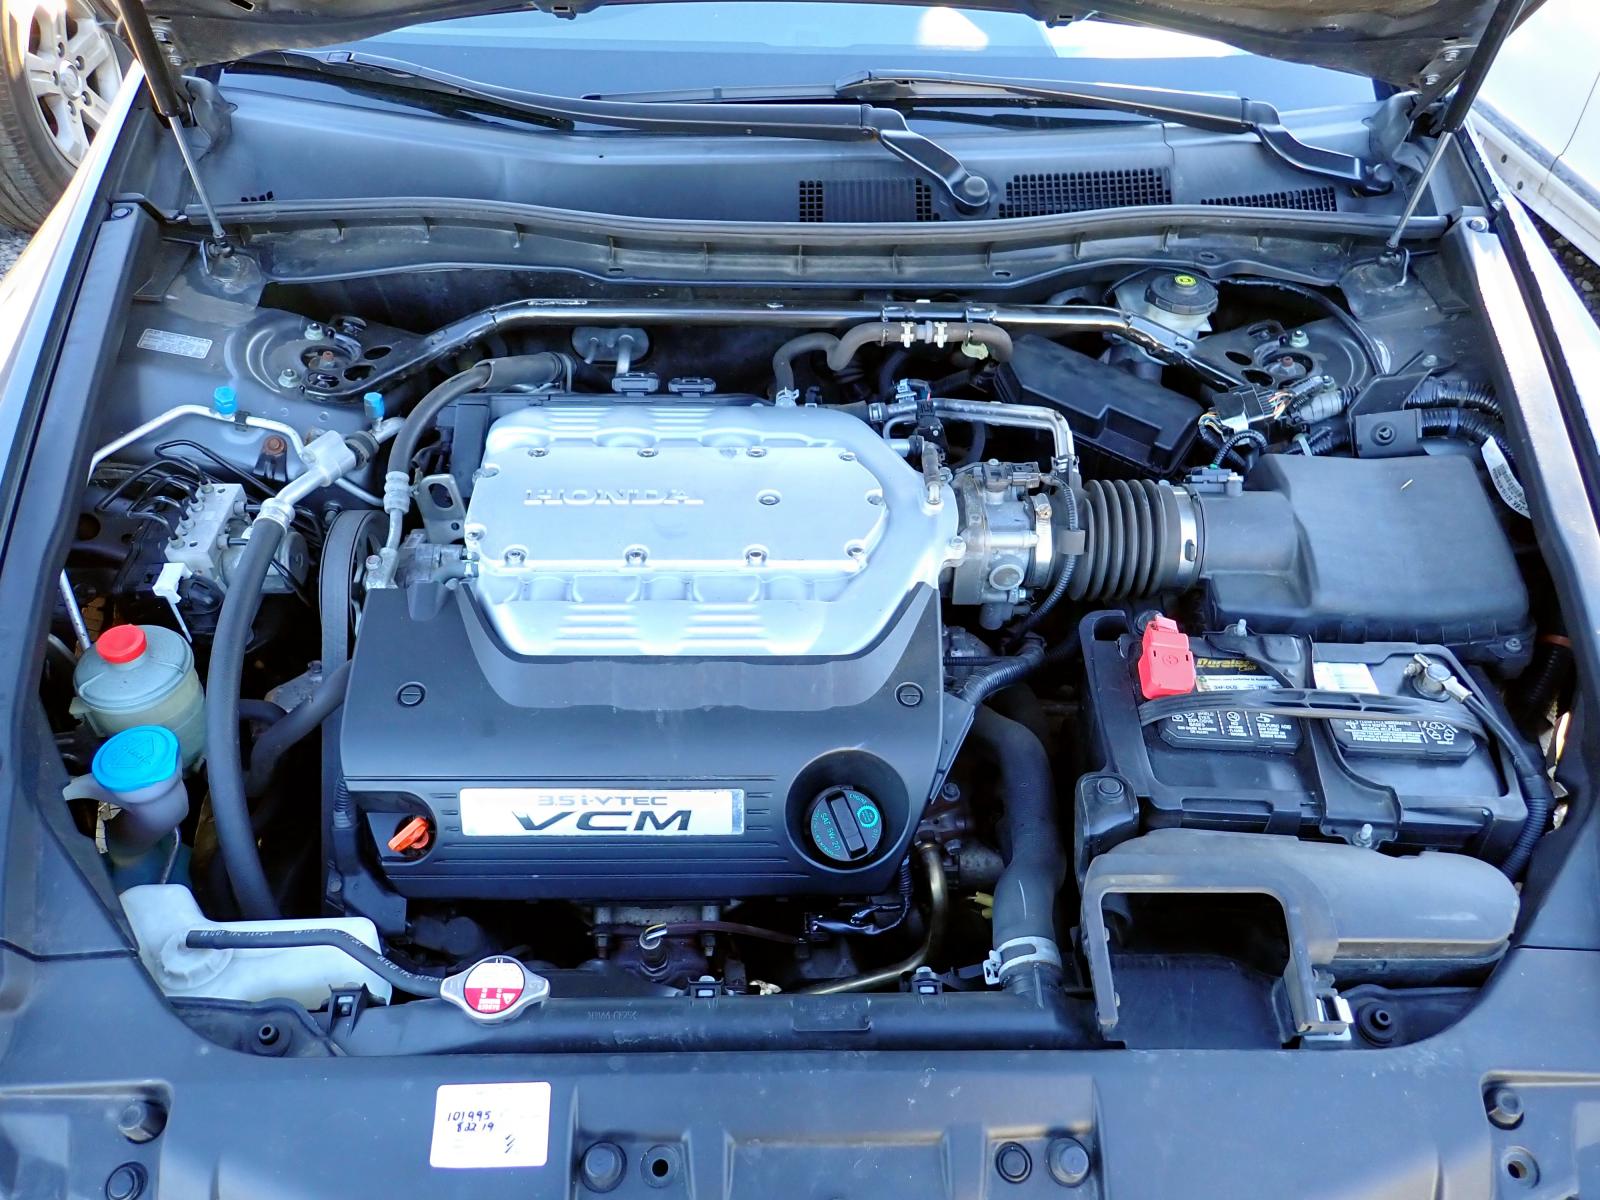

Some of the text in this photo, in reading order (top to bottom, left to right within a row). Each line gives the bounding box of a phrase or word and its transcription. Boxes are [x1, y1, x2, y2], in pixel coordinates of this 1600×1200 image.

[523, 488, 704, 506] HONDA
[538, 795, 575, 806] 3.5
[512, 809, 692, 832] VCM
[447, 1110, 492, 1122] 101995
